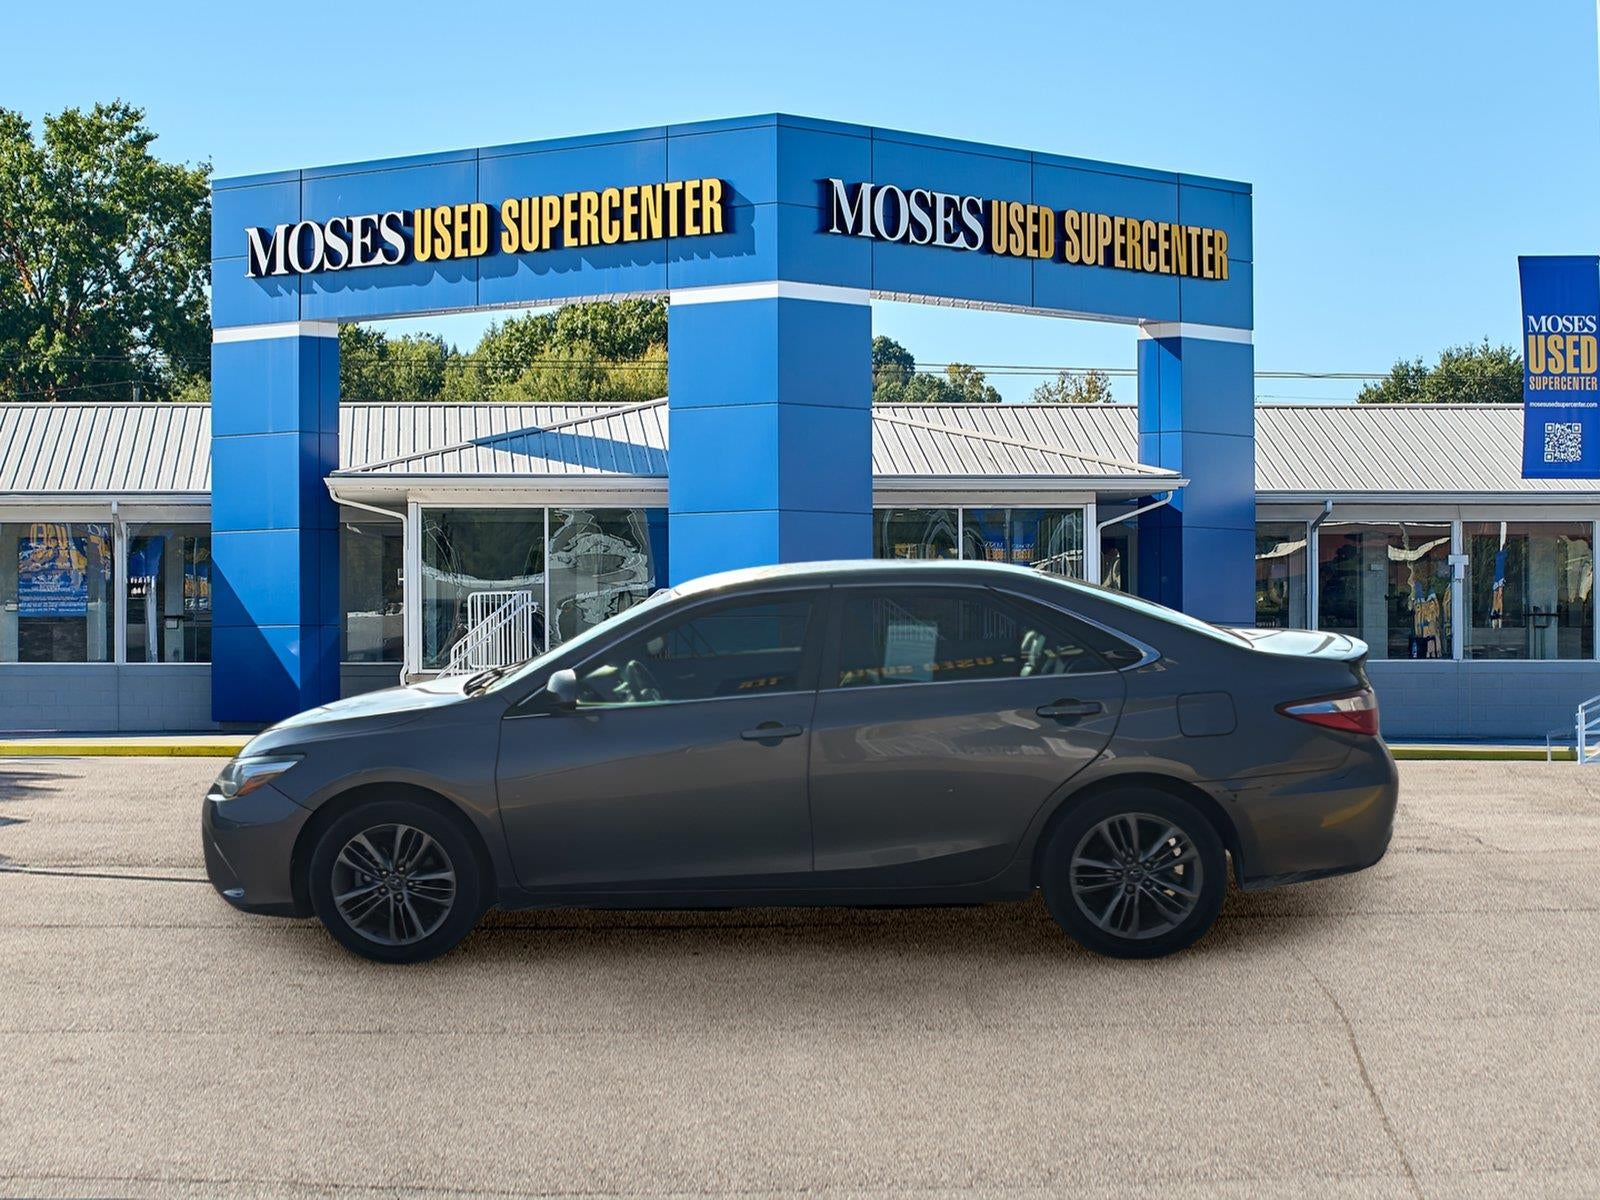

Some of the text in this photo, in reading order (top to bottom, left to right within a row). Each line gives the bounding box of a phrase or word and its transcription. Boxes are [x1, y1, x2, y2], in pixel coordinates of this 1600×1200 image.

[245, 178, 723, 278] MOSES USED SUPERCENTER
[829, 178, 1228, 279] MOSES USED SUPERCENTER
[1528, 315, 1597, 333] MOSES
[1528, 335, 1598, 374] USED
[1529, 376, 1597, 391] SUPERCENTER
